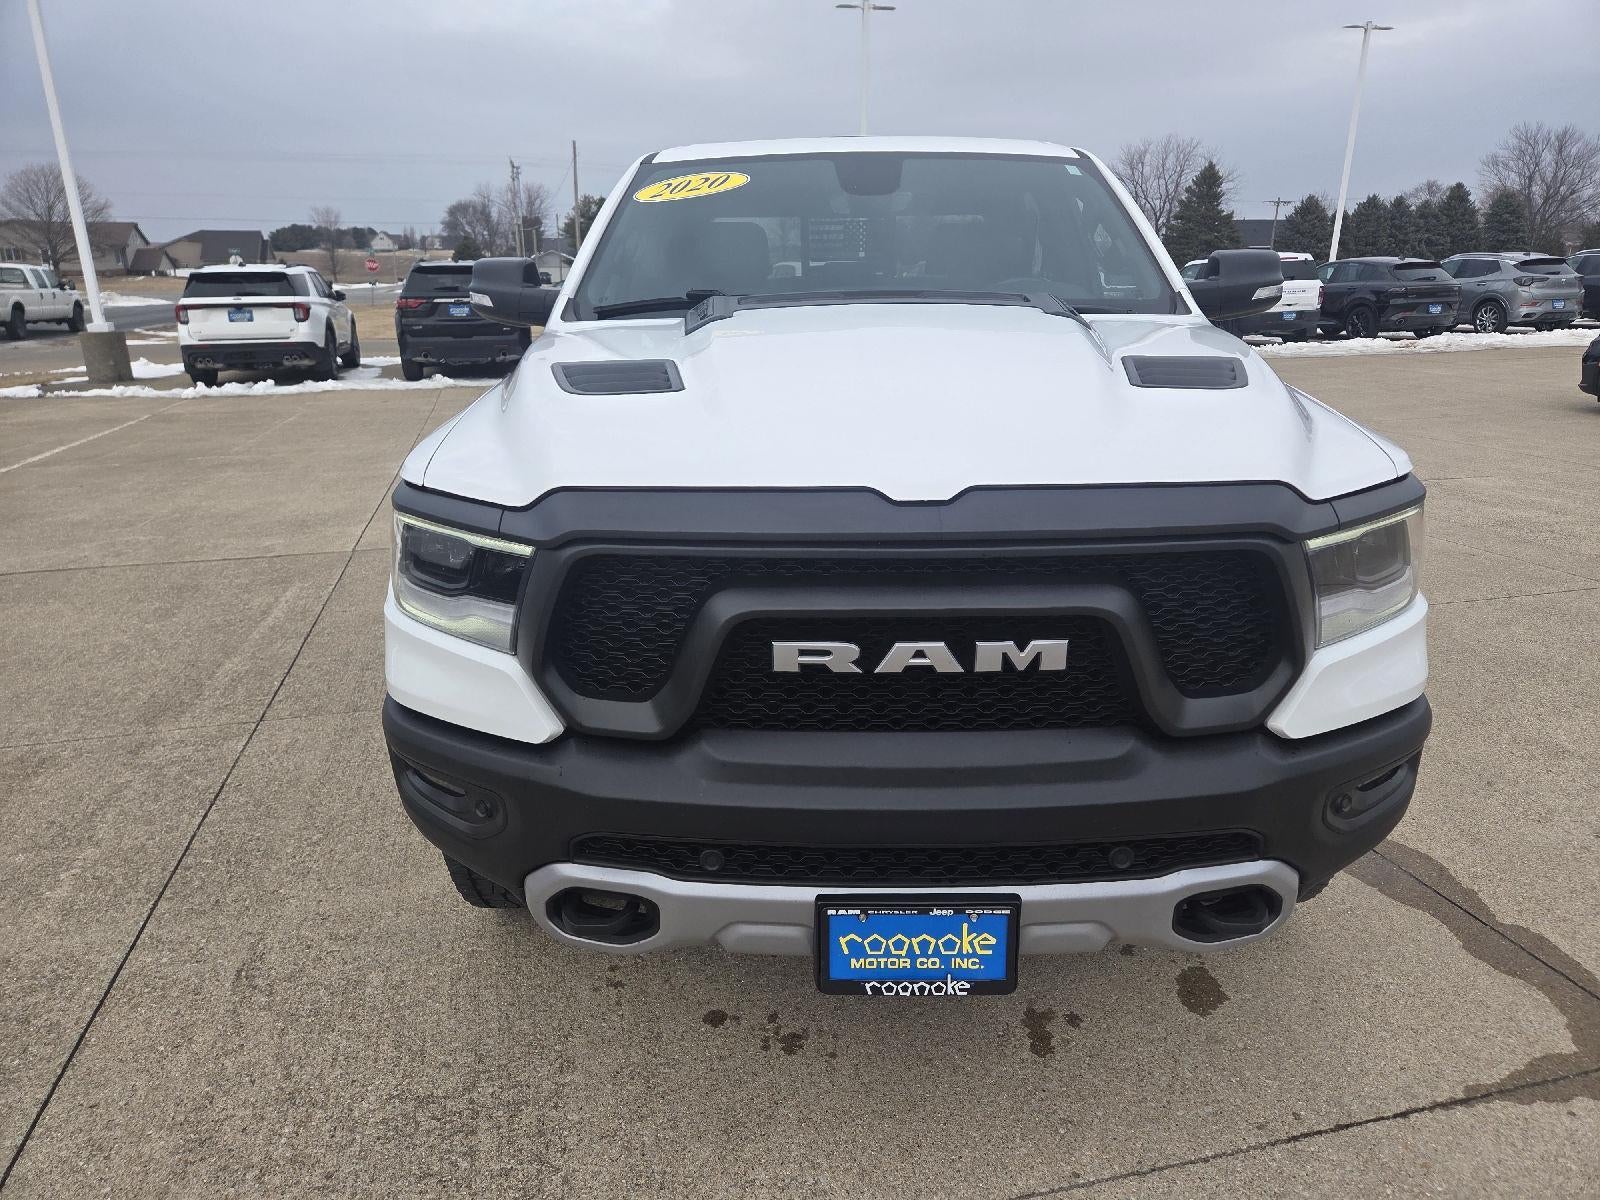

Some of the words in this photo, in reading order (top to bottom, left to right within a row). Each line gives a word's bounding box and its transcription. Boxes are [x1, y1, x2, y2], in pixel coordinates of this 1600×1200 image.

[649, 174, 731, 199] 2020
[771, 639, 1069, 673] RAM
[929, 908, 954, 917] Jeep
[839, 922, 997, 957] roanoke
[850, 957, 911, 969] MOTOR
[916, 957, 945, 969] CO.
[951, 957, 985, 969] INC.
[864, 973, 971, 997] roanoke
